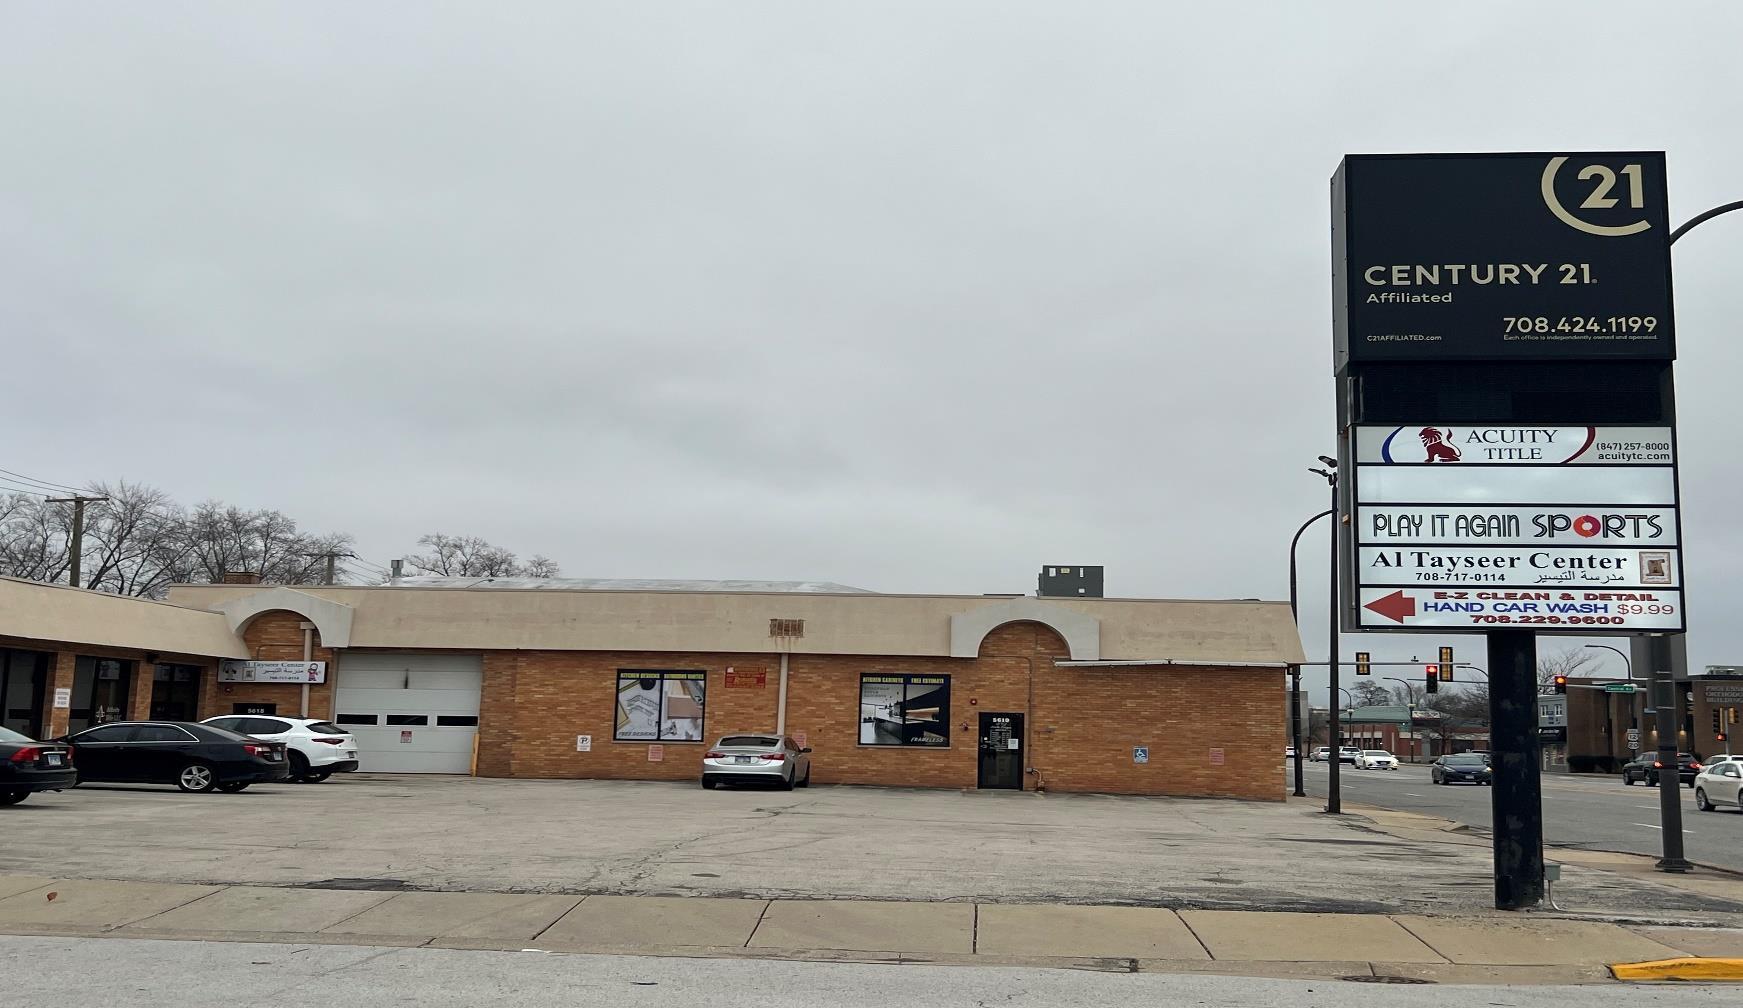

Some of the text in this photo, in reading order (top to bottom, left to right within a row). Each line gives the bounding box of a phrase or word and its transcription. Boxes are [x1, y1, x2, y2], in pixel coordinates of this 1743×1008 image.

[1364, 263, 1549, 286] CENTURY
[1366, 292, 1453, 304] Affiliated
[1503, 316, 1658, 333] 708.424.1199
[1366, 334, 1443, 342] C21AFFILIATED.com
[1465, 429, 1559, 444] ACUITY
[1596, 442, 1670, 451] (847) 257-8000
[1483, 448, 1543, 460] TITLE
[1598, 452, 1670, 461] acuitytc.com
[1372, 514, 1664, 539] PLAY IT AGAIN SPORTS
[1371, 550, 1628, 571] Al Tayseer Center
[1415, 572, 1506, 582] 708-717-0114
[1533, 570, 1625, 584] مدرسة التيسير
[1433, 591, 1660, 602] E-Z CLEAN & DETAIL
[1423, 602, 1674, 615] HAND CAR WASH $9.99
[1469, 614, 1625, 625] 708.229.9600
